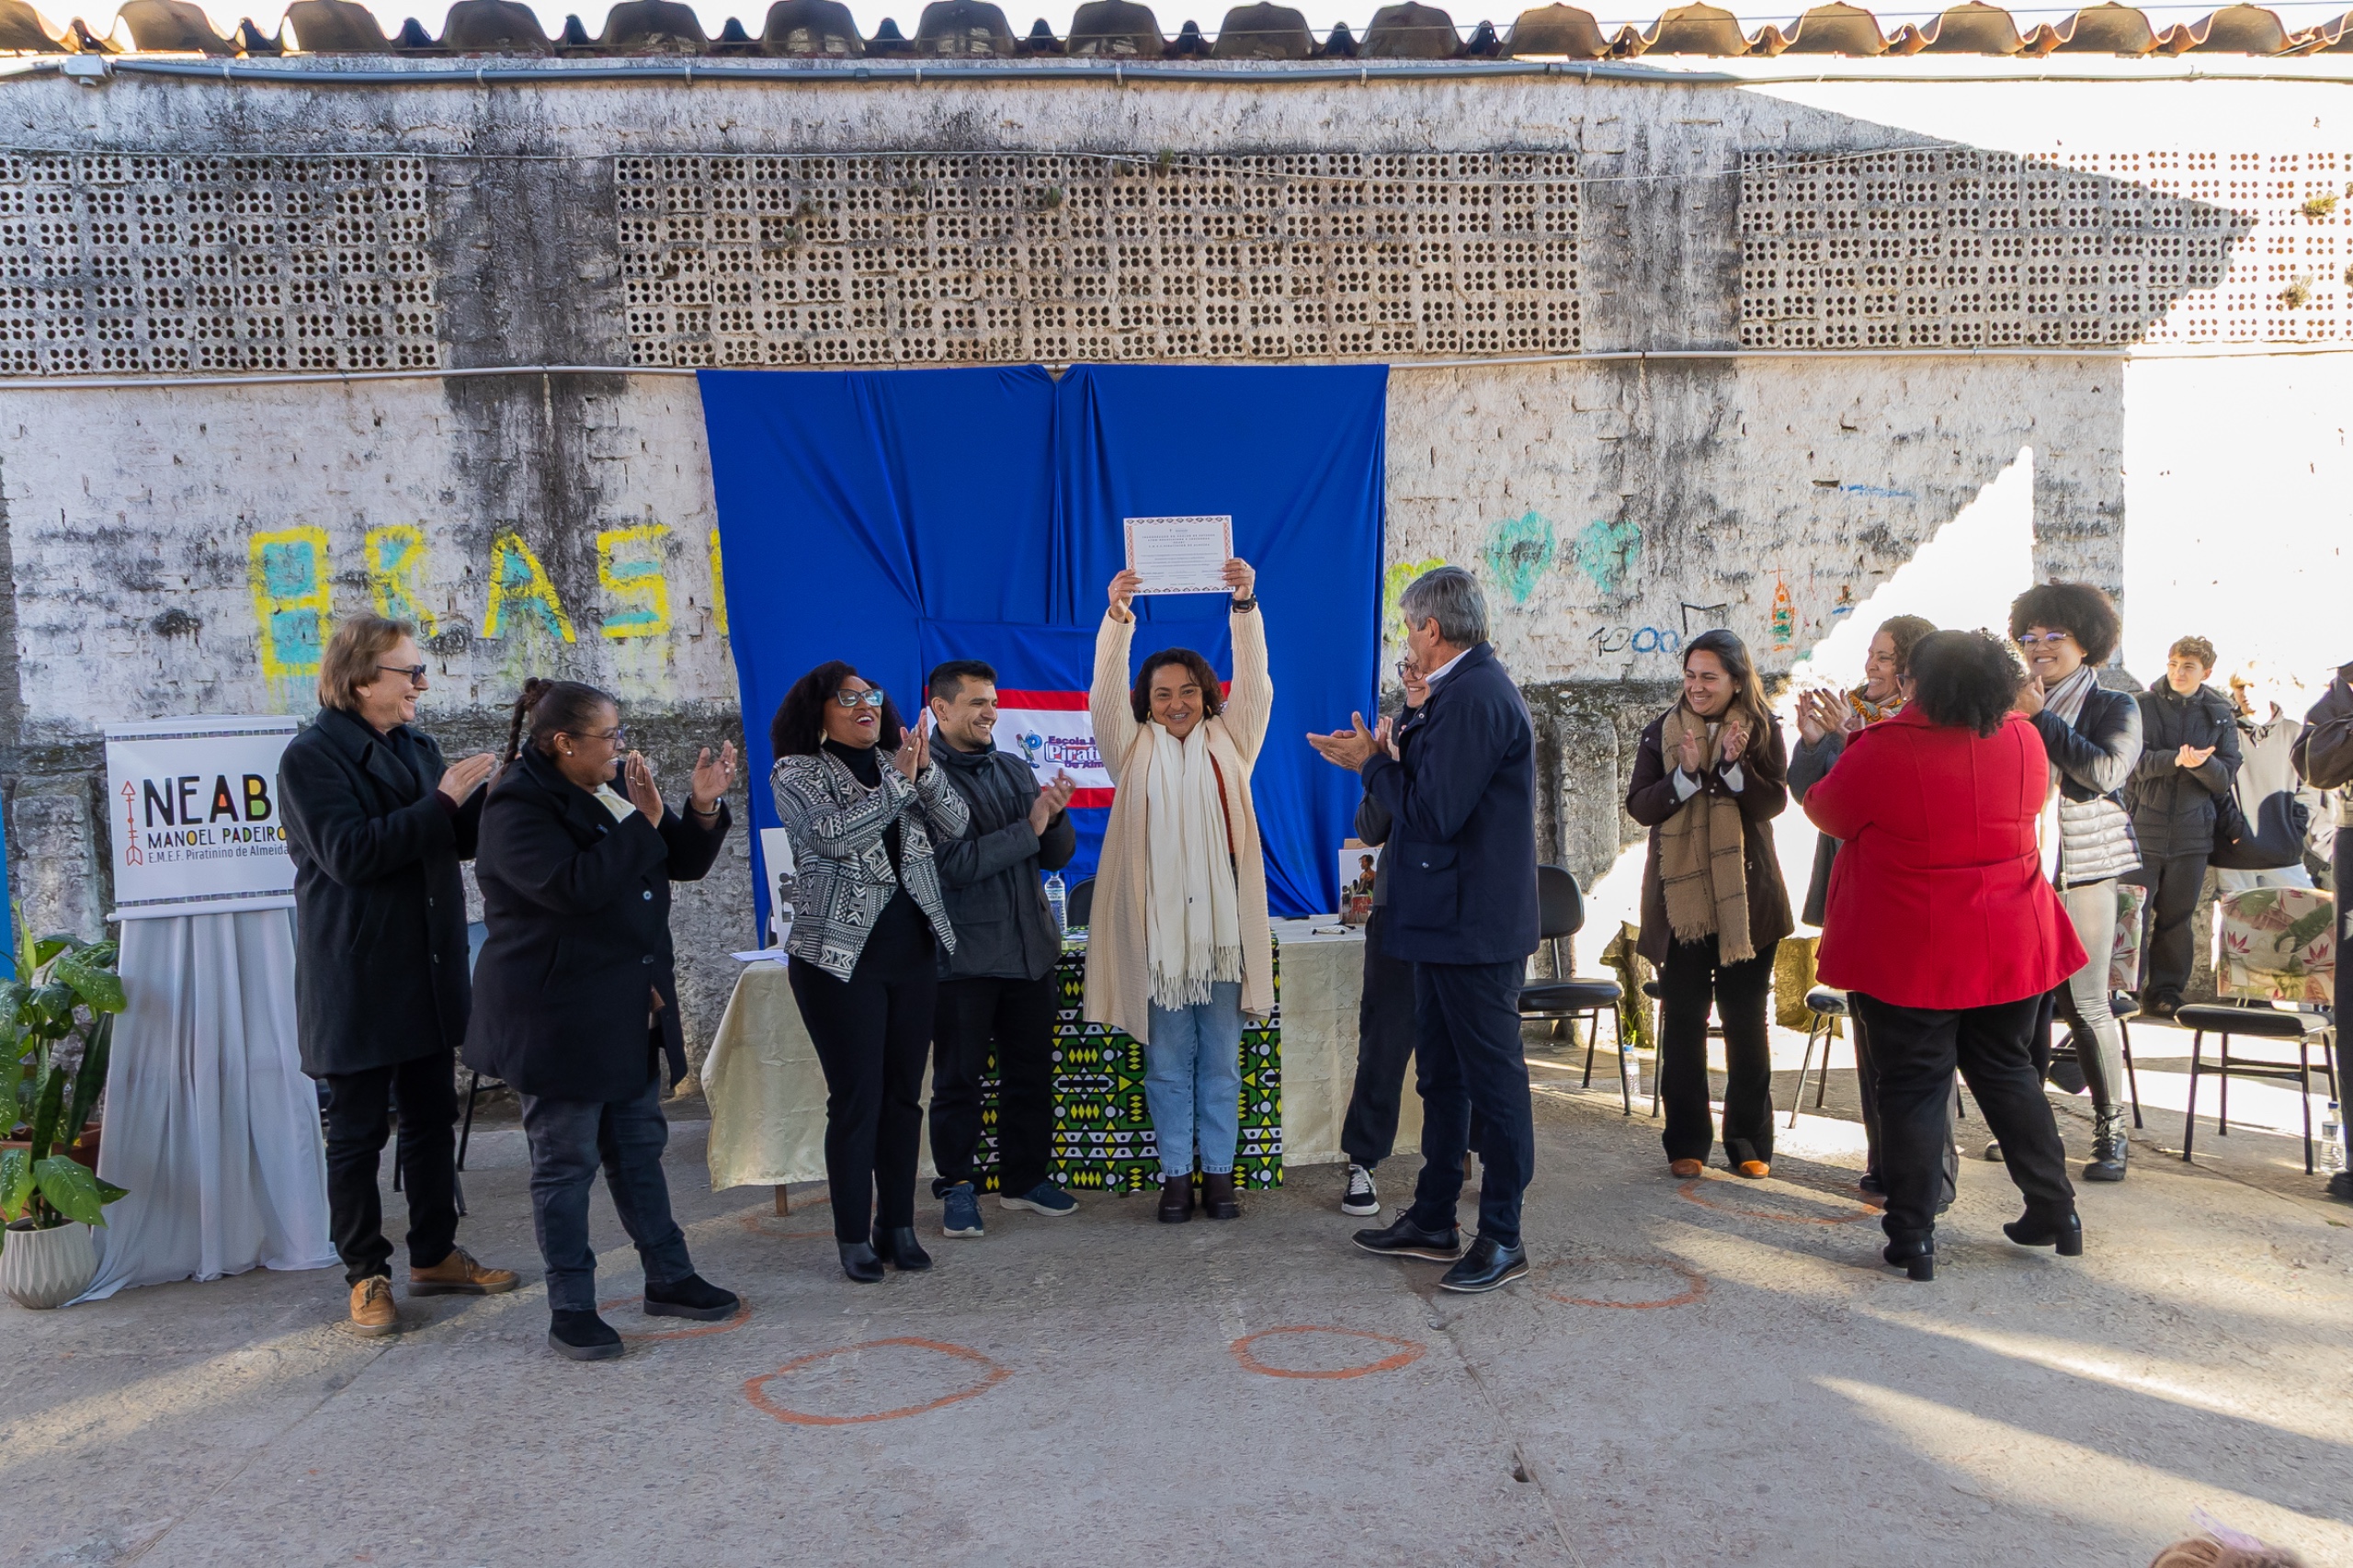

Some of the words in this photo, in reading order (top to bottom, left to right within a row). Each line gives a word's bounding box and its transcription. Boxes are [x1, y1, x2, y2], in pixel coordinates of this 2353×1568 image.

[142, 774, 279, 827] NEAB
[148, 829, 216, 849] MANOEL
[222, 825, 287, 844] PADEIRO
[148, 851, 184, 864] E.M.E.F.
[187, 847, 233, 860] Piratinino
[235, 846, 247, 857] de
[250, 844, 289, 856] Almeida
